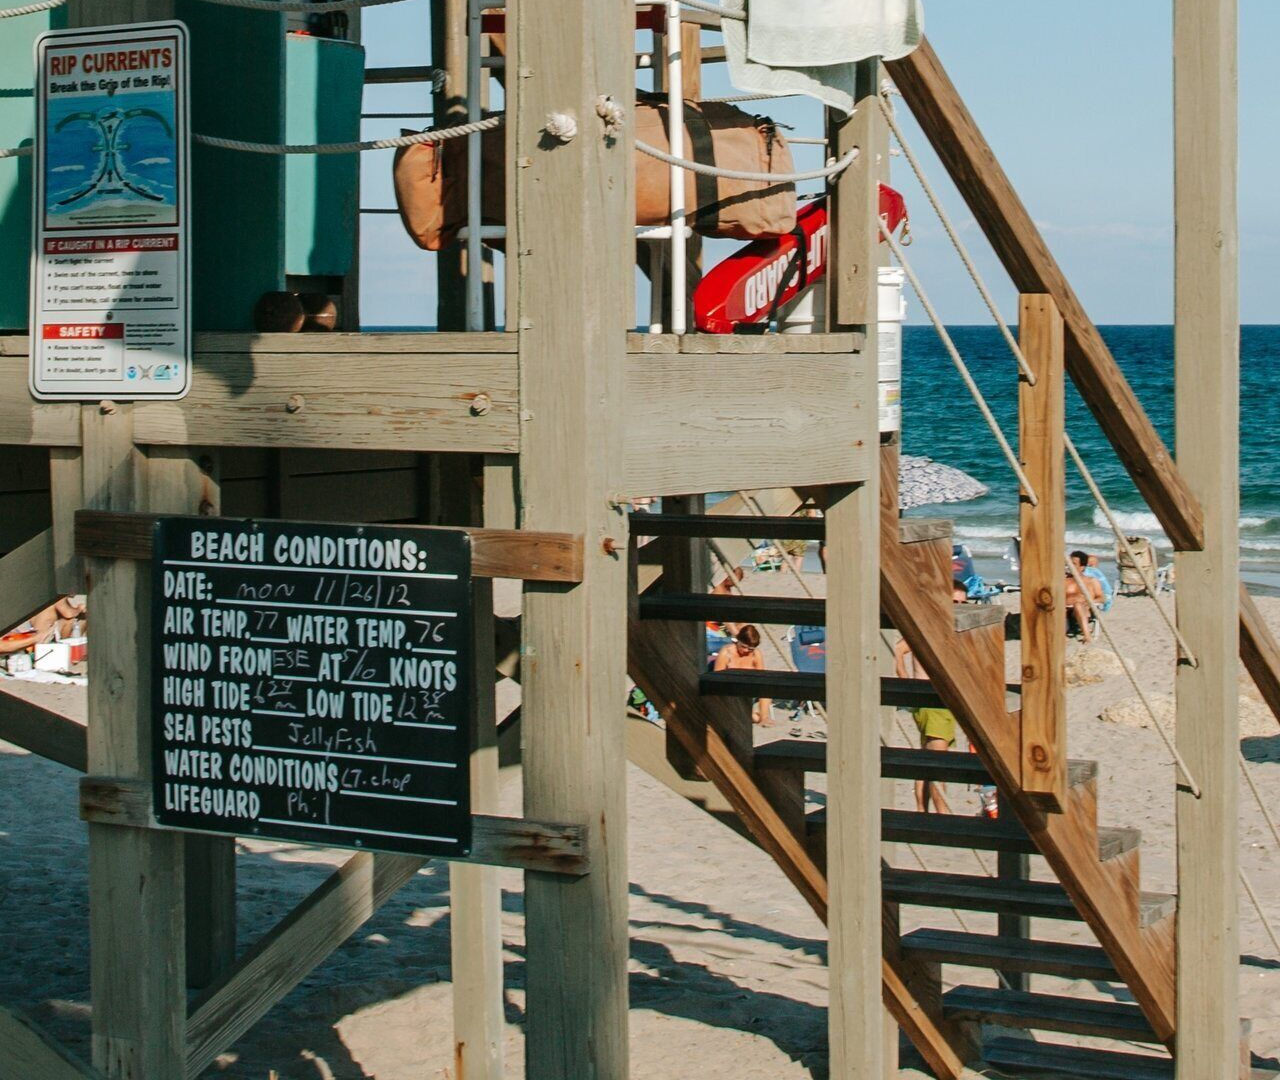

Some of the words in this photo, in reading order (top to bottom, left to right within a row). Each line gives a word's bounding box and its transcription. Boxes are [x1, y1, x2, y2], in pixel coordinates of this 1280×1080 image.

[50, 55, 77, 76] RIP
[82, 48, 172, 74] CURRENTS
[50, 82, 78, 94] Break
[81, 80, 96, 92] the
[99, 79, 118, 91] Grip
[120, 77, 131, 89] of
[133, 76, 149, 88] the
[151, 74, 171, 88] Rip!
[47, 241, 57, 251] IF
[58, 239, 95, 251] CAUGHT
[95, 239, 106, 250] IN
[106, 239, 115, 249] A
[115, 238, 131, 249] RIP
[132, 237, 176, 248] CURRENT
[60, 326, 106, 338] SAFETY
[190, 531, 264, 562] BEACH
[274, 534, 427, 571] CONDITIONS:
[163, 570, 213, 600] DATE:
[163, 606, 195, 635] AIR
[200, 608, 251, 639] TEMP.
[254, 610, 279, 631] 77
[287, 614, 349, 646] WATER
[355, 617, 412, 650] TEMP.
[414, 620, 445, 643] 76
[163, 642, 212, 672] WIND
[219, 645, 272, 677] FROM
[273, 648, 310, 668] ESE
[318, 652, 342, 682] AT
[390, 656, 458, 692] KNOTS
[163, 675, 205, 707] HIGH
[211, 681, 251, 711] TIDE
[307, 688, 345, 719] LOW
[352, 691, 393, 723] TIDE
[163, 712, 195, 743] SEA
[202, 715, 252, 748] PESTS
[164, 749, 222, 780] WATER
[229, 753, 338, 792] CONDITIONS
[165, 782, 260, 819] LIFEGUARD
